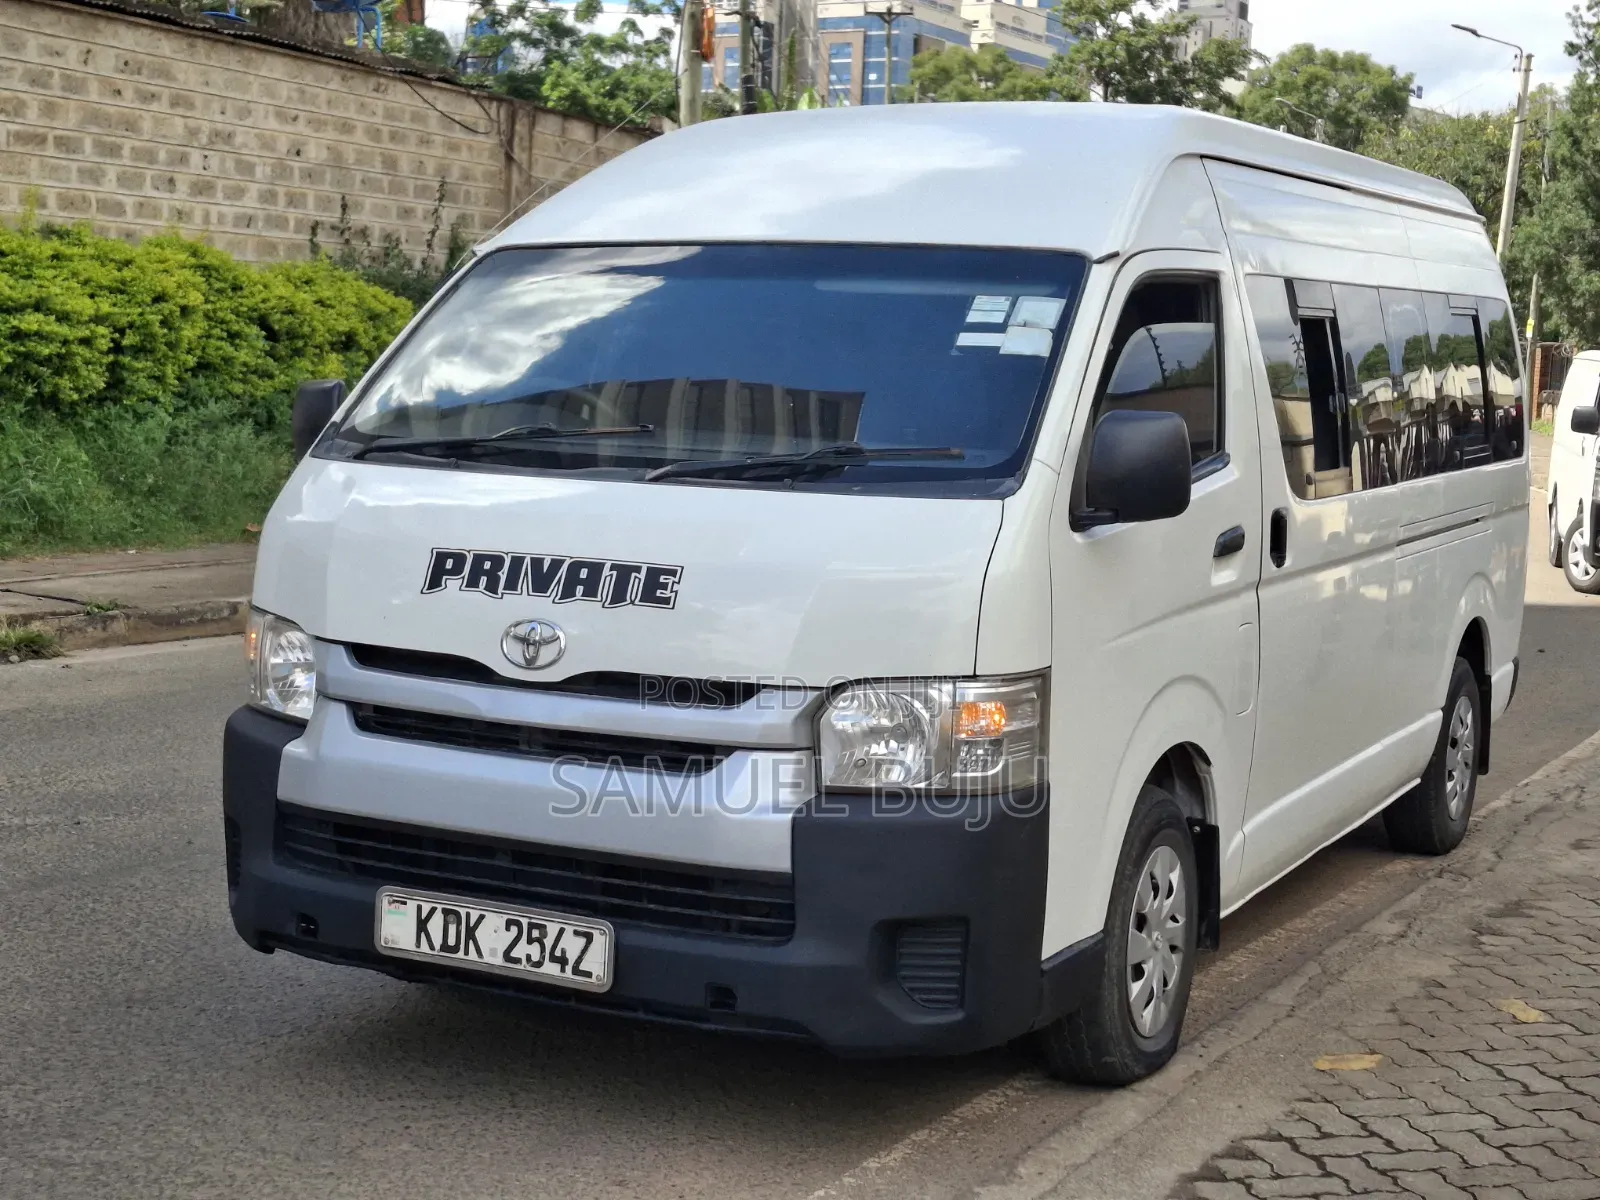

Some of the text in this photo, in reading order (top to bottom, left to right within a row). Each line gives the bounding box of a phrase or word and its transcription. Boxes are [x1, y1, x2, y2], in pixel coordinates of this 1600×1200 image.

[420, 547, 685, 610] PRIVATE
[414, 903, 595, 979] KDK 254Z
